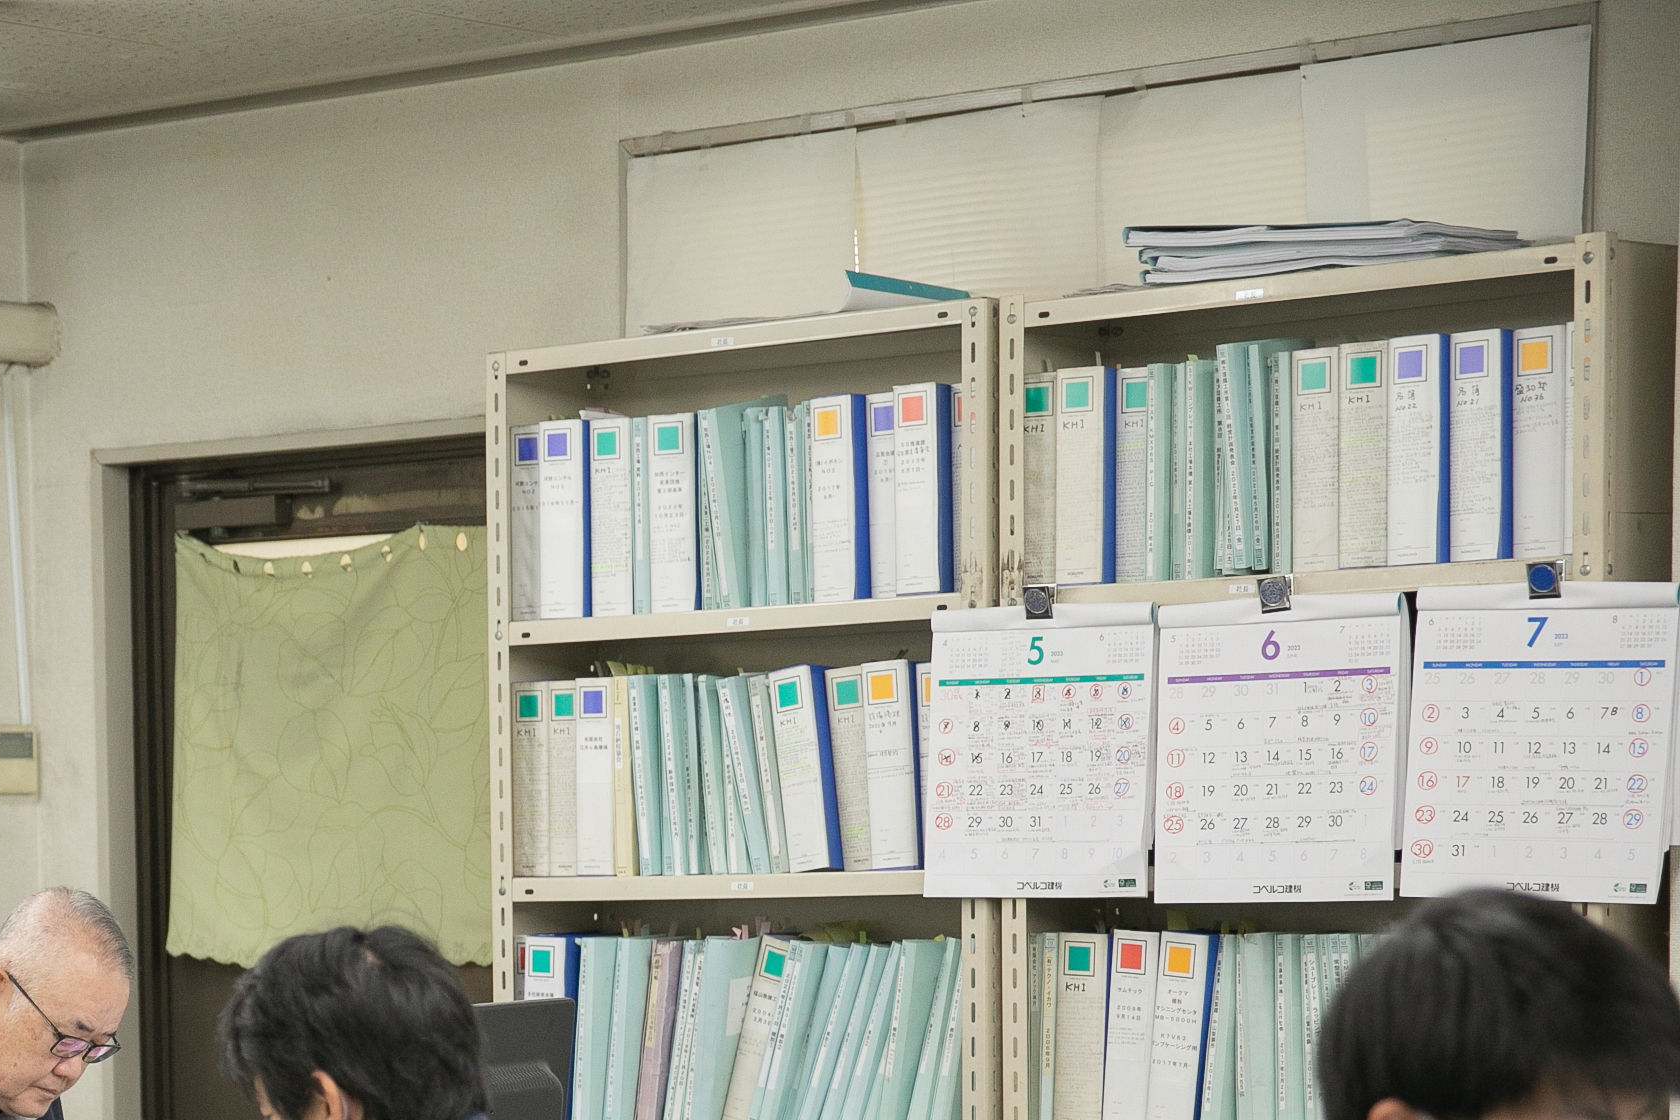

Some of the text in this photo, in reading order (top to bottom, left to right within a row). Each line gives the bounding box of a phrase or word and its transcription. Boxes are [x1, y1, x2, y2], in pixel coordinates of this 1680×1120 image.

[1348, 394, 1370, 404] KHI
[1300, 401, 1322, 411] KHI
[1063, 419, 1085, 430] KHI
[1125, 419, 1144, 428] KHI
[1527, 617, 1549, 648] 7
[1261, 630, 1280, 660] 6
[1027, 636, 1044, 665] 5
[780, 717, 797, 727] KHI
[838, 714, 855, 724] KHI
[517, 728, 537, 738] KHI
[554, 727, 570, 735] KHI
[1425, 741, 1645, 756] 9 10 11 12 13 14 15
[938, 782, 1128, 796] 21 22 23 24 25 26 27
[1170, 780, 1374, 798] 18 19 20 21 22 23 24
[936, 816, 1042, 827] 28 29 30 31
[1417, 809, 1641, 826] 23 24 25 26 27 28 29
[1167, 815, 1343, 831] 25 26 27 28 29 30
[1016, 881, 1062, 890] コベルコ建機
[1253, 885, 1302, 894] コベルコ建機
[1506, 882, 1560, 892] コベルコ建機
[1065, 982, 1086, 992] KHI
[1117, 987, 1143, 995] サムテック
[1156, 1006, 1198, 1016] マシニングセンタ
